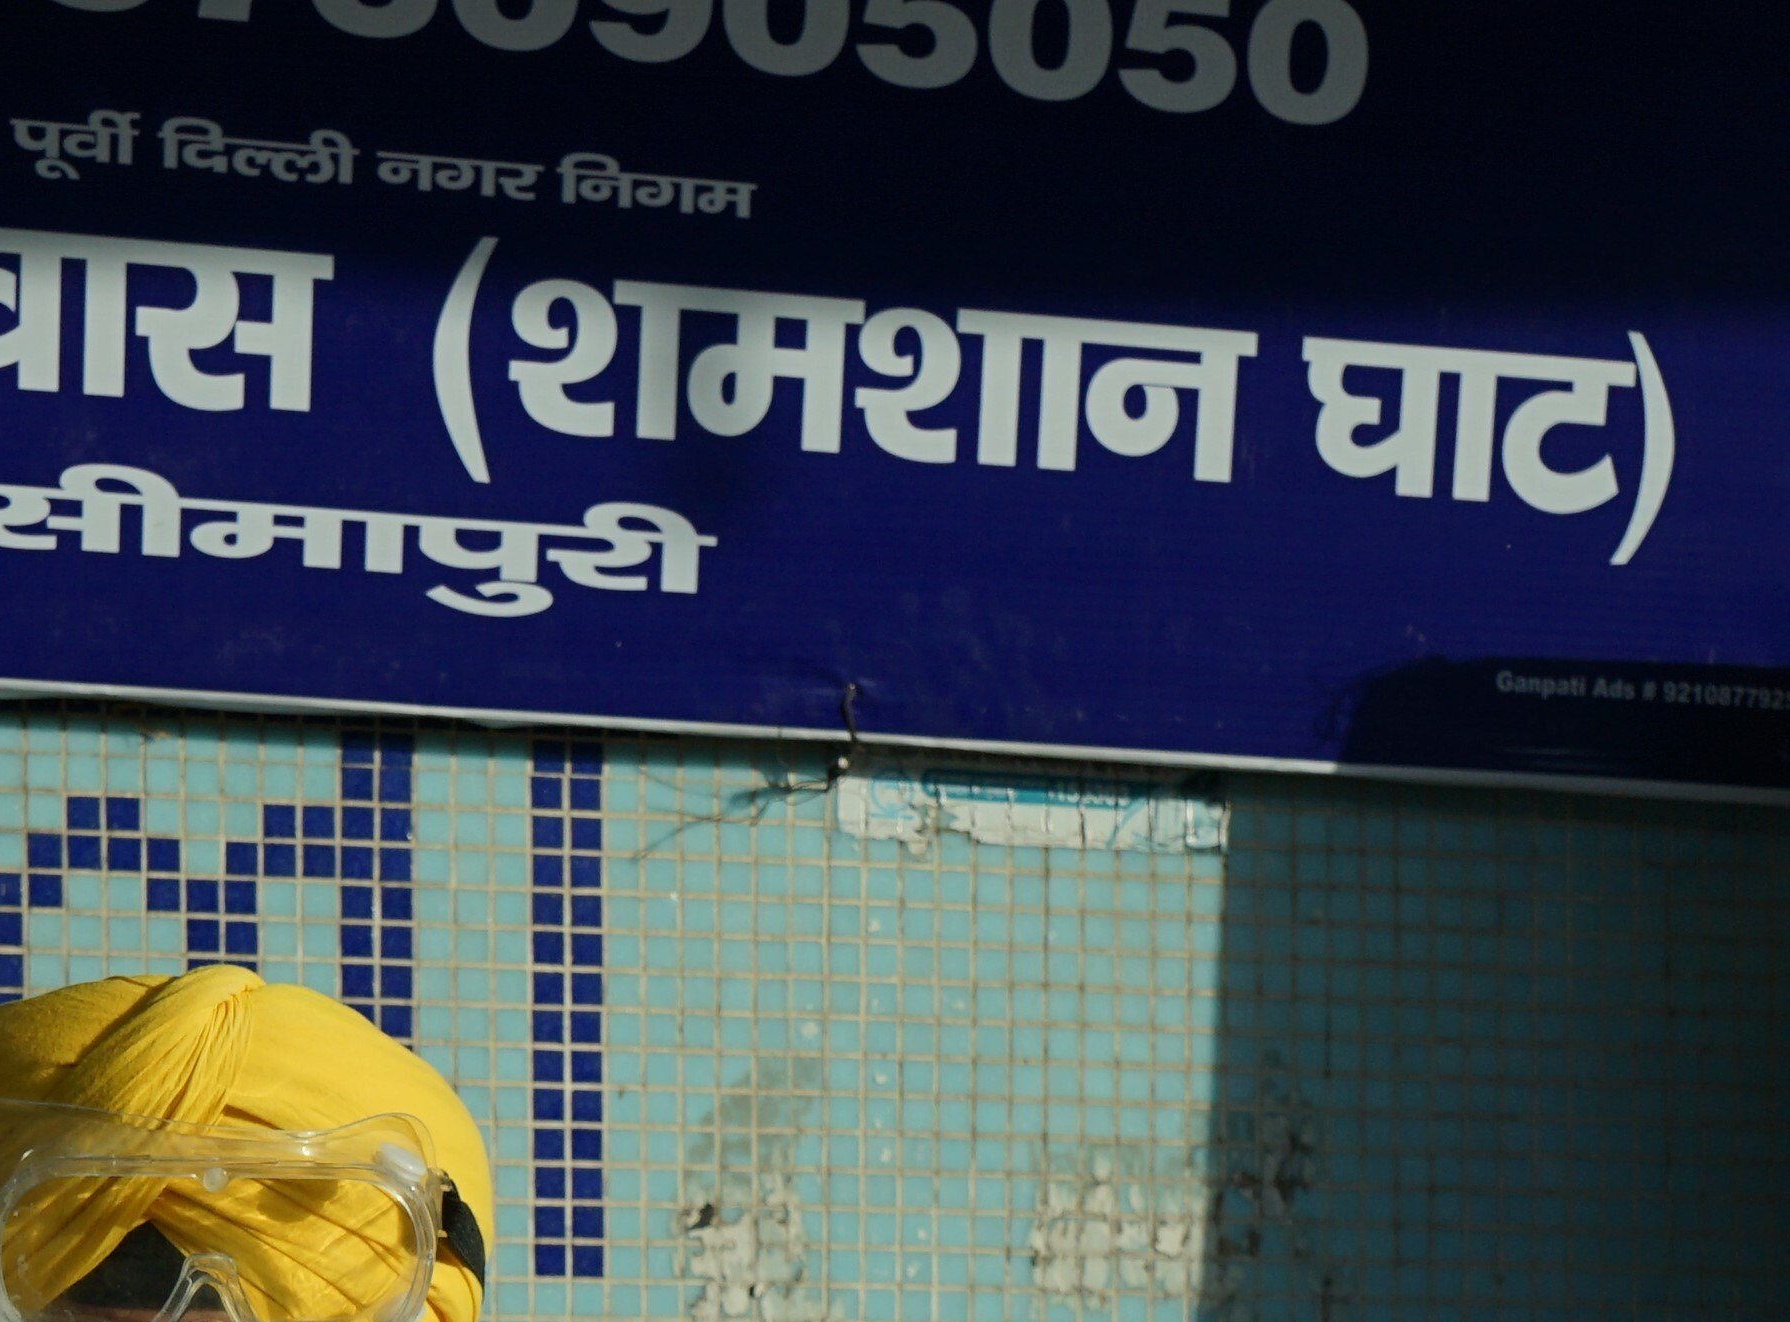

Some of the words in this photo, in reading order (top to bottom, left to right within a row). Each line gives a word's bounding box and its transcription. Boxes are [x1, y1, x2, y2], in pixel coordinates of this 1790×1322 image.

[11, 110, 138, 182] पूर्वी
[156, 117, 355, 192] दिल्ली
[377, 148, 545, 203] नगर
[556, 151, 756, 221] निगम
[432, 236, 1260, 485] (शमशान
[1302, 330, 1677, 567] घाट)
[1495, 669, 1587, 700] Ganpati
[1592, 677, 1635, 700] Ads
